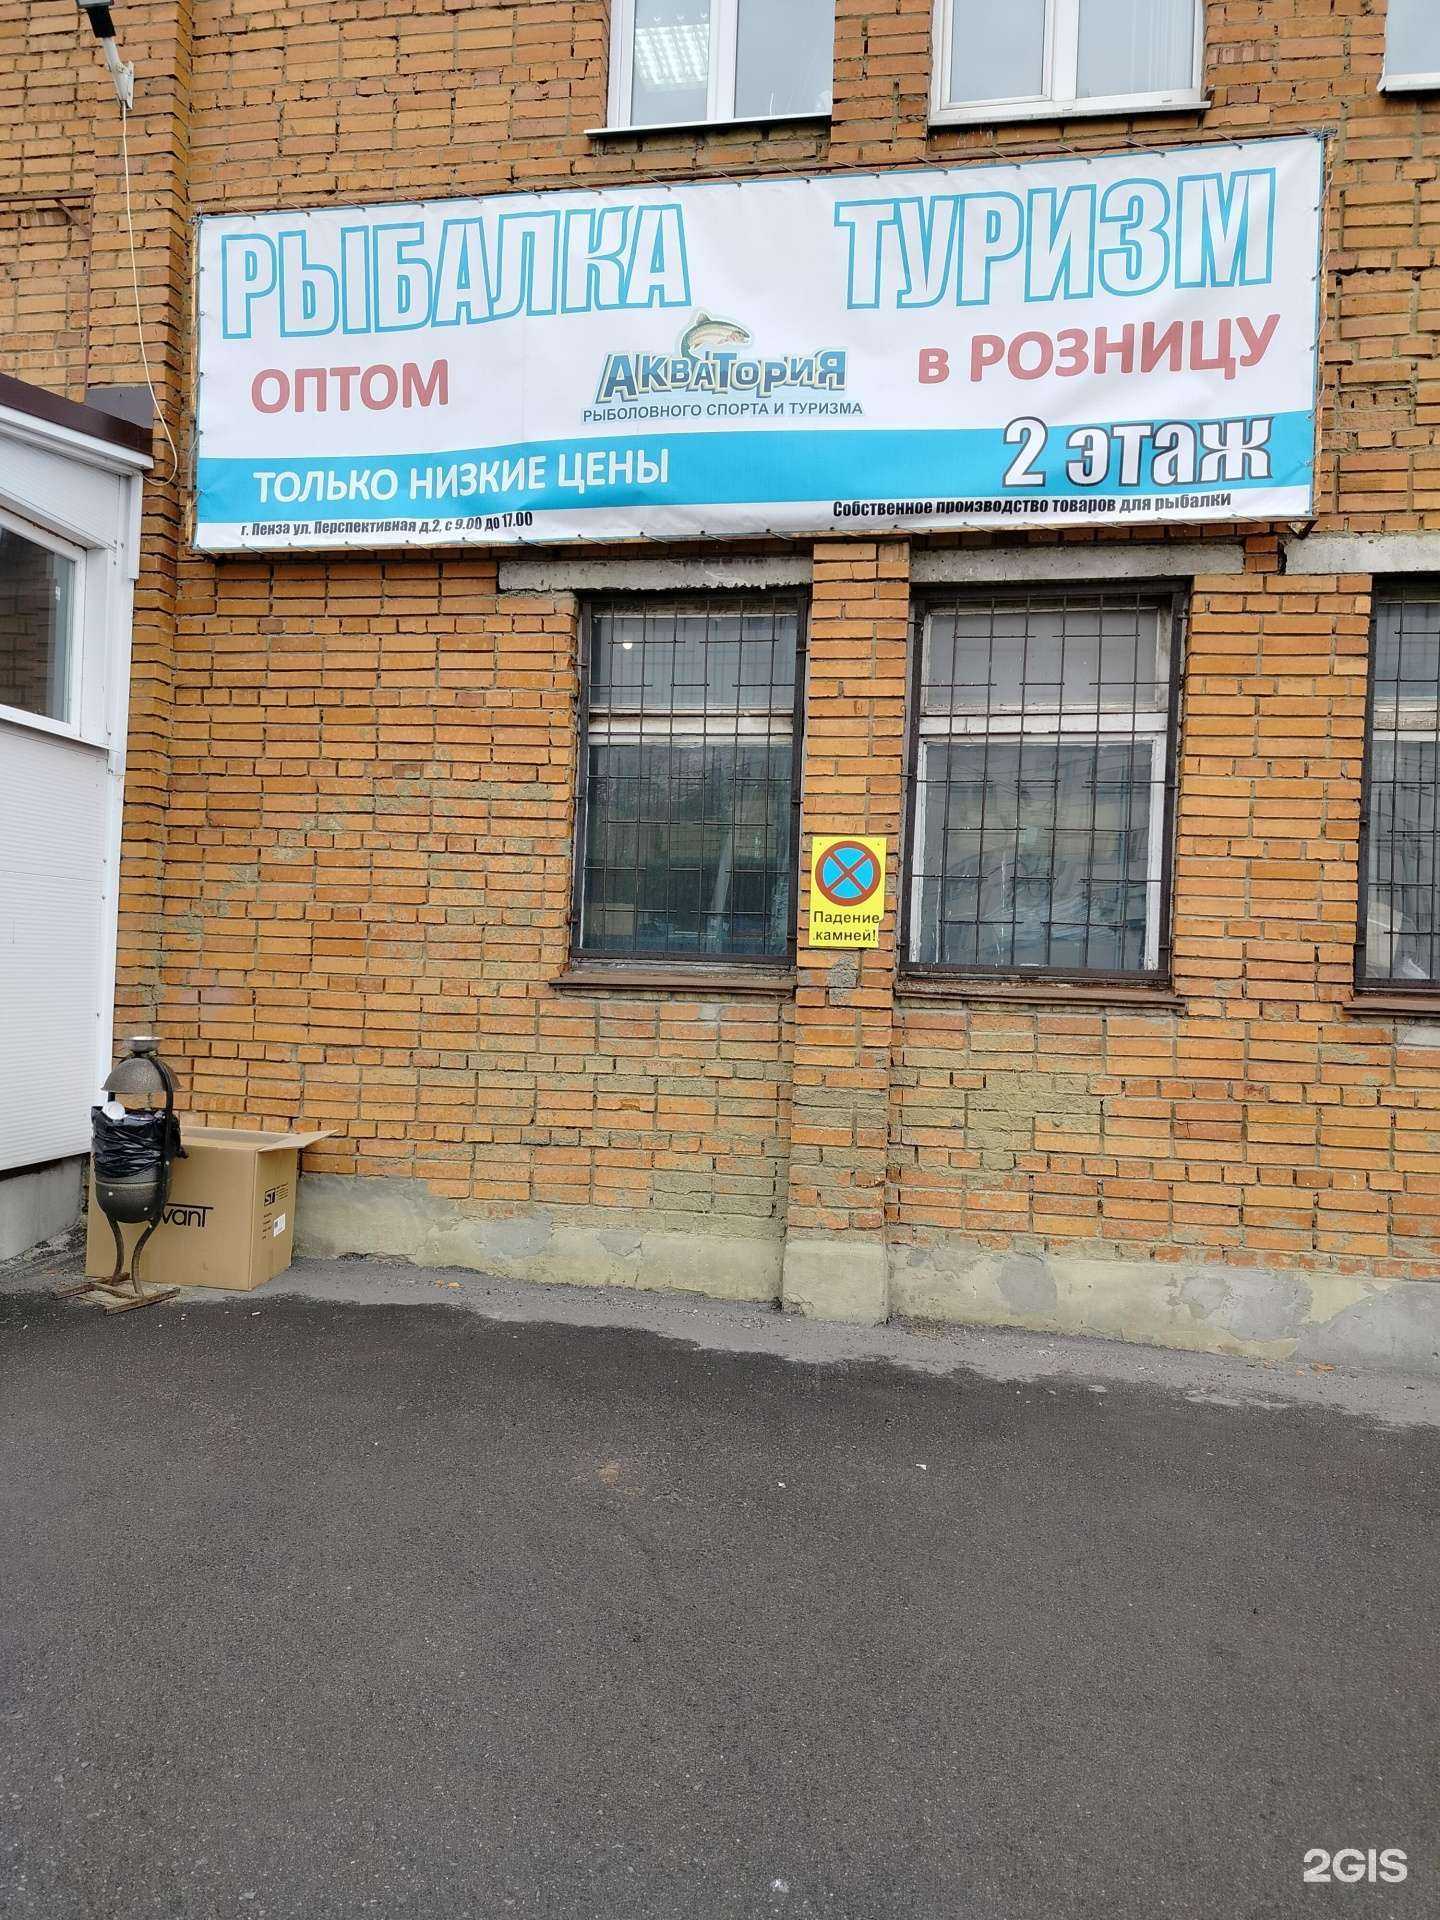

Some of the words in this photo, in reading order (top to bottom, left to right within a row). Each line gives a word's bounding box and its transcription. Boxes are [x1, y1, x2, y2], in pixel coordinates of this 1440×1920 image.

[834, 168, 1277, 310] ТУРИЗМ
[221, 203, 692, 340] РЫБАЛКА
[969, 313, 1281, 382] РОЗНИЦУ
[251, 358, 450, 414] ОПТОМ
[583, 404, 702, 422] РЫБОЛОВНОГО
[706, 402, 770, 417] СПОРТА
[774, 403, 785, 416] И
[789, 402, 864, 416] ТУРИЗМА
[252, 468, 399, 504] ТОЛЬКО
[408, 455, 545, 501] НИЗКИЕ
[557, 448, 669, 494] ЦЕНЫ
[1002, 416, 1049, 489] 2
[1065, 415, 1274, 488] этаж
[240, 525, 250, 536] г.
[252, 523, 291, 536] Пенза
[293, 525, 313, 536] ул.
[314, 521, 416, 535] Перспективная
[445, 520, 452, 531] с
[455, 516, 482, 531] 9.00
[484, 516, 501, 531] до
[502, 511, 533, 528] 17.00
[832, 499, 933, 518] Собственное
[935, 497, 1049, 515] производство
[1052, 496, 1117, 514] товаров
[1119, 495, 1152, 513] для
[1155, 492, 1232, 512] рыбалки
[813, 910, 880, 925] Падение
[815, 929, 876, 941] камней!
